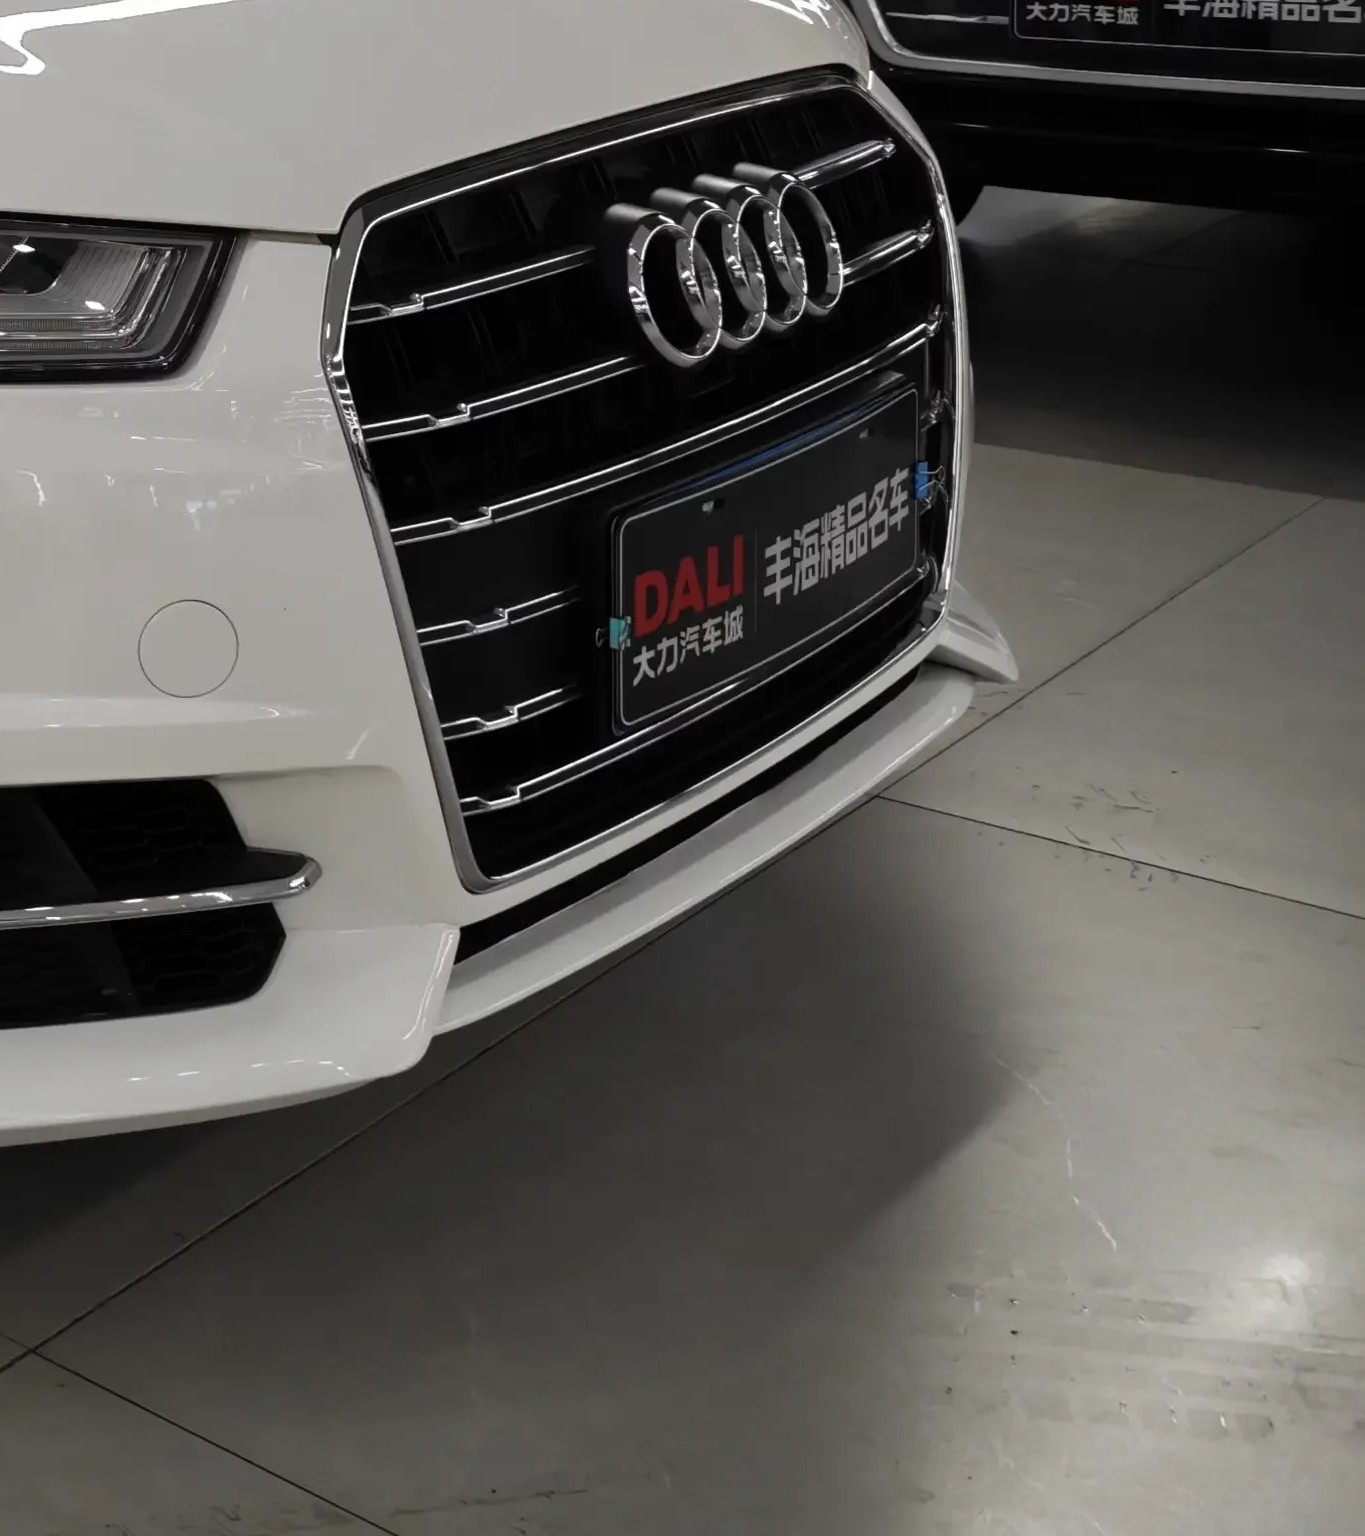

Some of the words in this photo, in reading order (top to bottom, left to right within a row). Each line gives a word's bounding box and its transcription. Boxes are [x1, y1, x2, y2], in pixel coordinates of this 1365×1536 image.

[1026, 1, 1140, 26] 大力汽车城
[763, 467, 910, 604] 丰海精品名车
[633, 535, 744, 637] DALI
[633, 605, 744, 686] 大力汽车城
